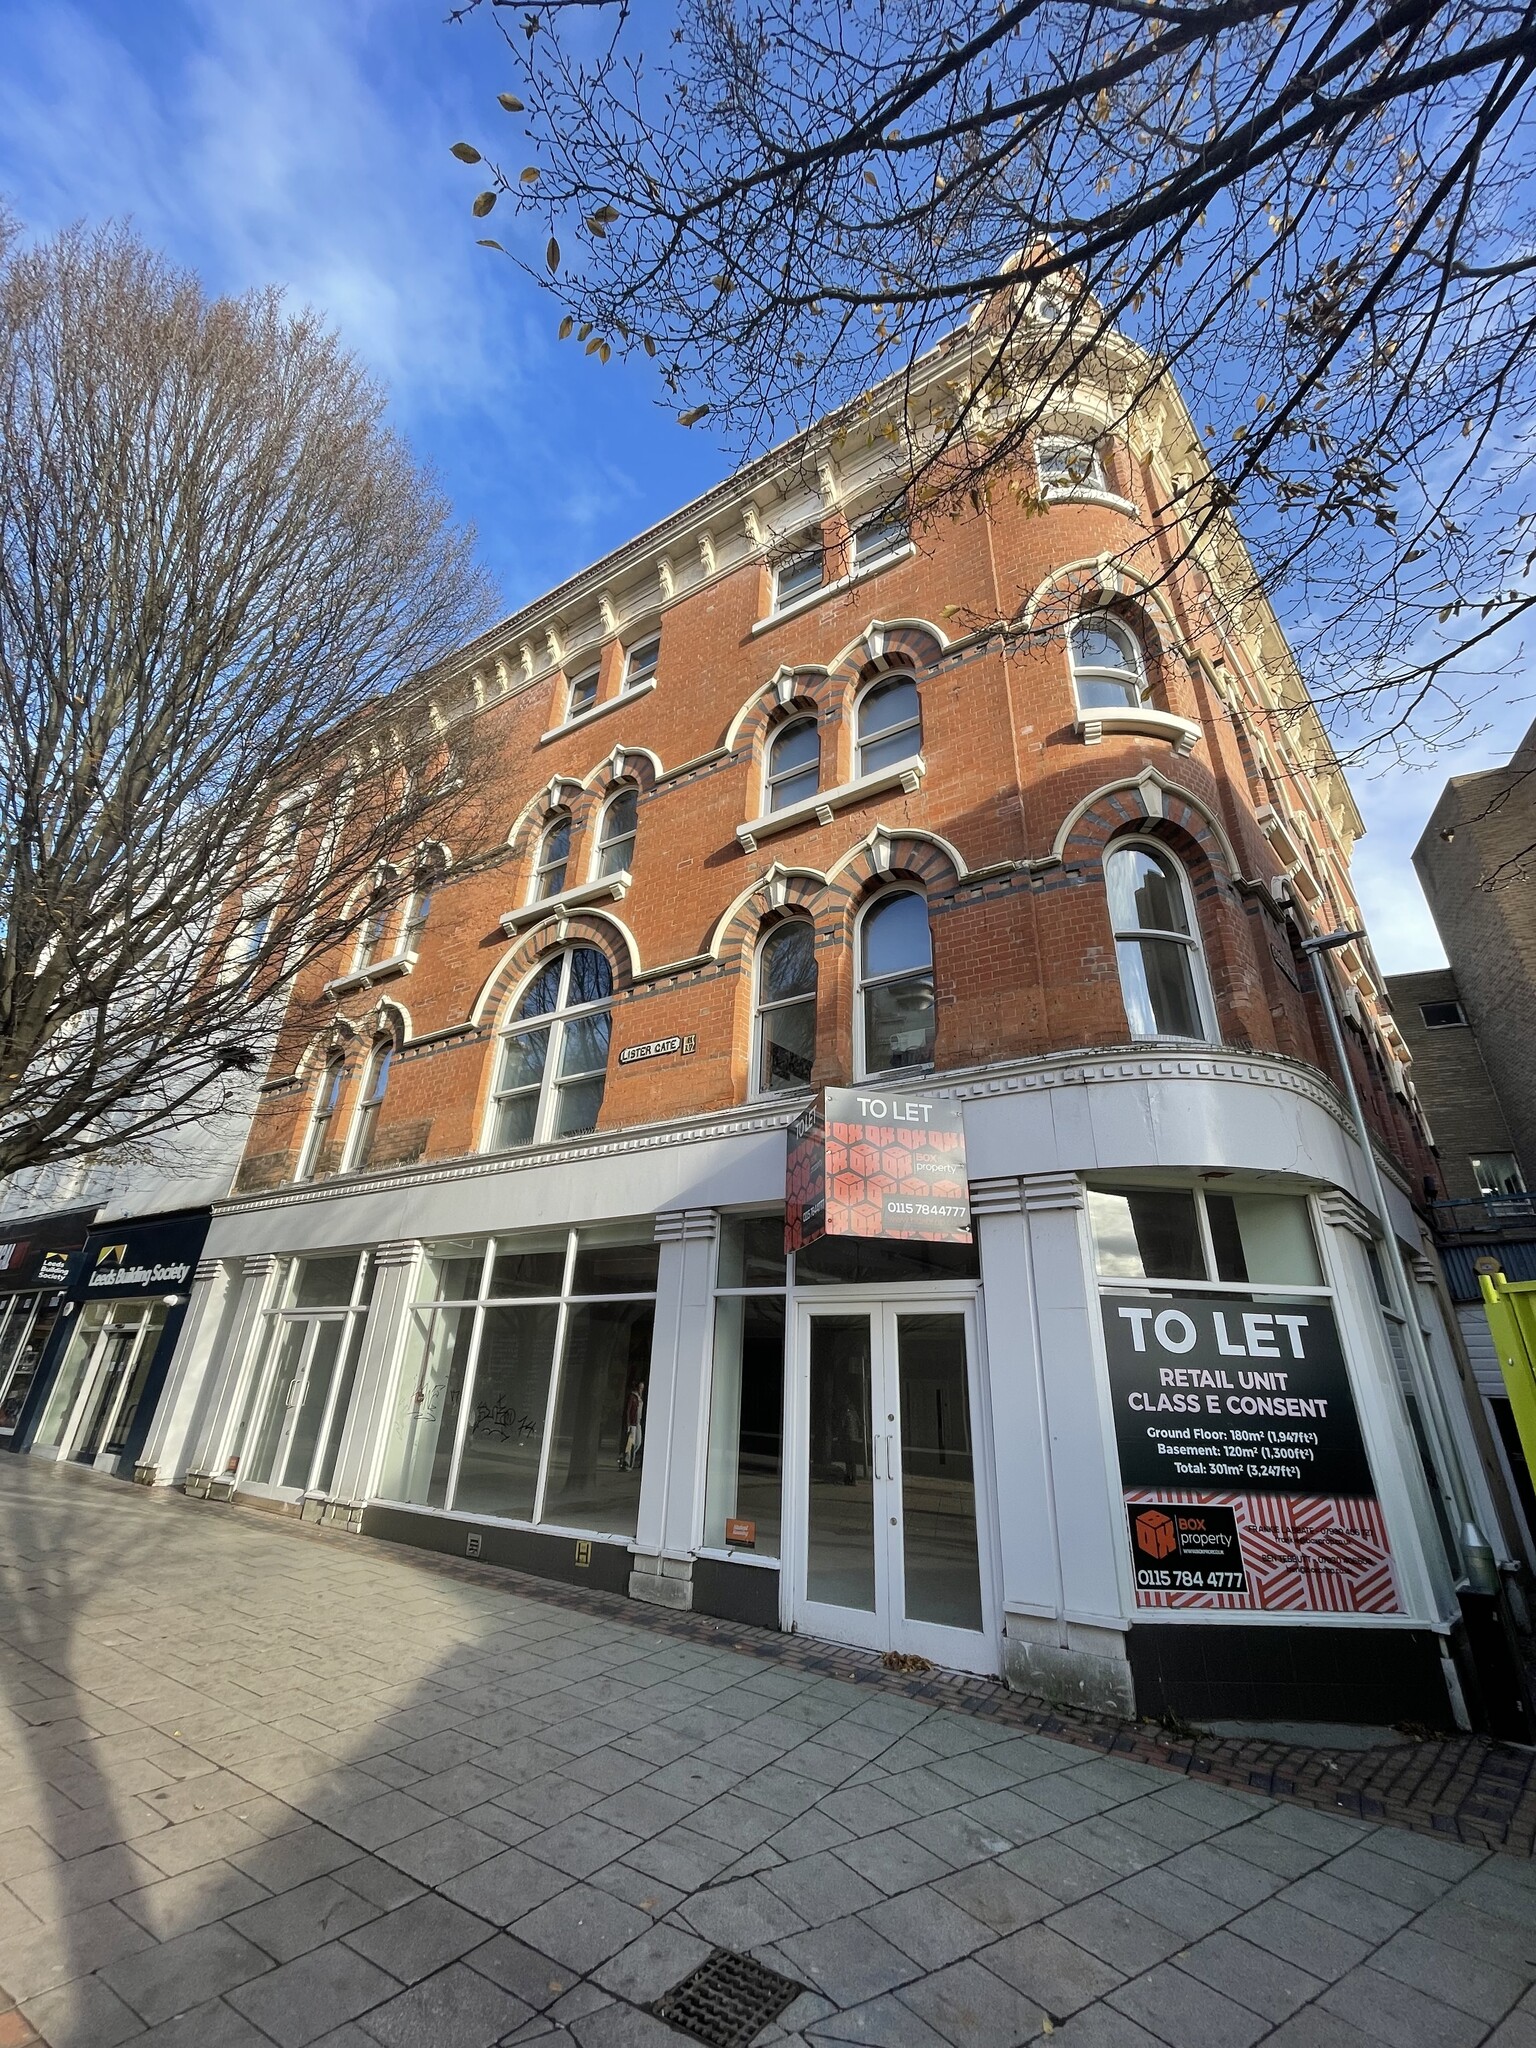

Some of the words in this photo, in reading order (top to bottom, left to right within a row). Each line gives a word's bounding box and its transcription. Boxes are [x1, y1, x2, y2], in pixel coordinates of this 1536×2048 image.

[622, 1046, 651, 1060] LISTER
[655, 1040, 676, 1052] GATE
[856, 1097, 888, 1119] TO
[892, 1101, 933, 1123] LET
[915, 1162, 957, 1175] property
[887, 1201, 914, 1215] 0115
[40, 1265, 69, 1275] Building
[43, 1259, 65, 1268] Leeds
[38, 1272, 67, 1282] Society
[88, 1268, 117, 1287] Leeds
[116, 1265, 153, 1287] Building
[150, 1262, 191, 1284] Society
[1117, 1306, 1198, 1355] TO
[1212, 1310, 1310, 1360] LET
[1159, 1367, 1234, 1389] RETAIL
[1238, 1371, 1289, 1391] UNIT
[1127, 1391, 1202, 1414] CLASS
[1206, 1394, 1222, 1414] E
[1226, 1396, 1329, 1418] CONSENT
[1146, 1426, 1191, 1440] Ground
[1193, 1428, 1228, 1442] Floor:
[1157, 1443, 1222, 1457] Basement:
[1174, 1461, 1208, 1475] Total:
[1178, 1518, 1206, 1531] BOX
[1180, 1532, 1232, 1548] property
[1137, 1569, 1172, 1586] 0115
[1172, 1570, 1204, 1587] 784
[1206, 1571, 1243, 1588] 4777
